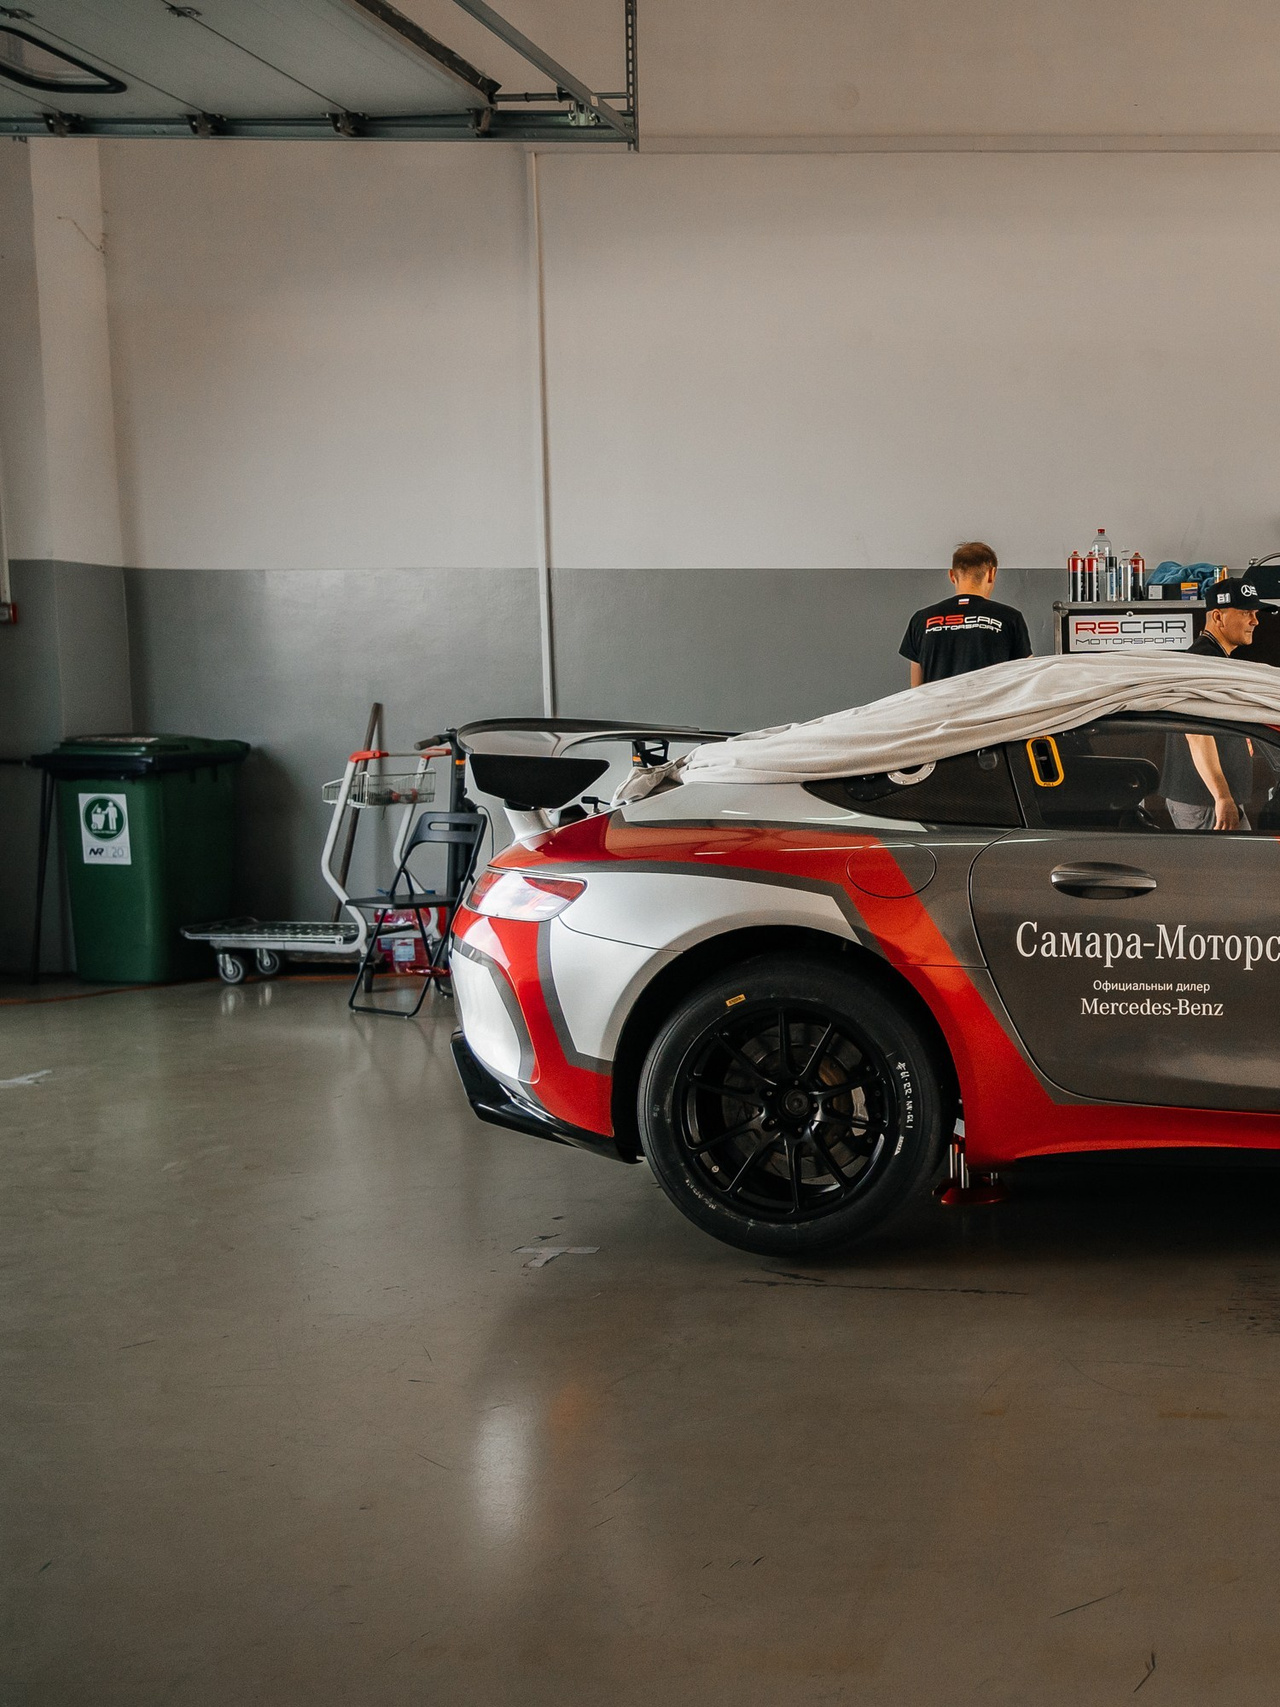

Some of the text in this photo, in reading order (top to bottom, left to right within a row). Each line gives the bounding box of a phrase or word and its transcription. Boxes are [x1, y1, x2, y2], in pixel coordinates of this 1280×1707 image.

[926, 614, 1003, 629] RSCAR
[1075, 620, 1187, 635] RSCAR
[925, 623, 1002, 634] MOTORSPORT
[1075, 636, 1187, 646] MOTORSPORT
[112, 847, 124, 858] 20
[1016, 921, 1280, 971] Самара-Моторс
[1175, 982, 1211, 994] дилер
[1080, 998, 1224, 1016] Mercedes-Benz
